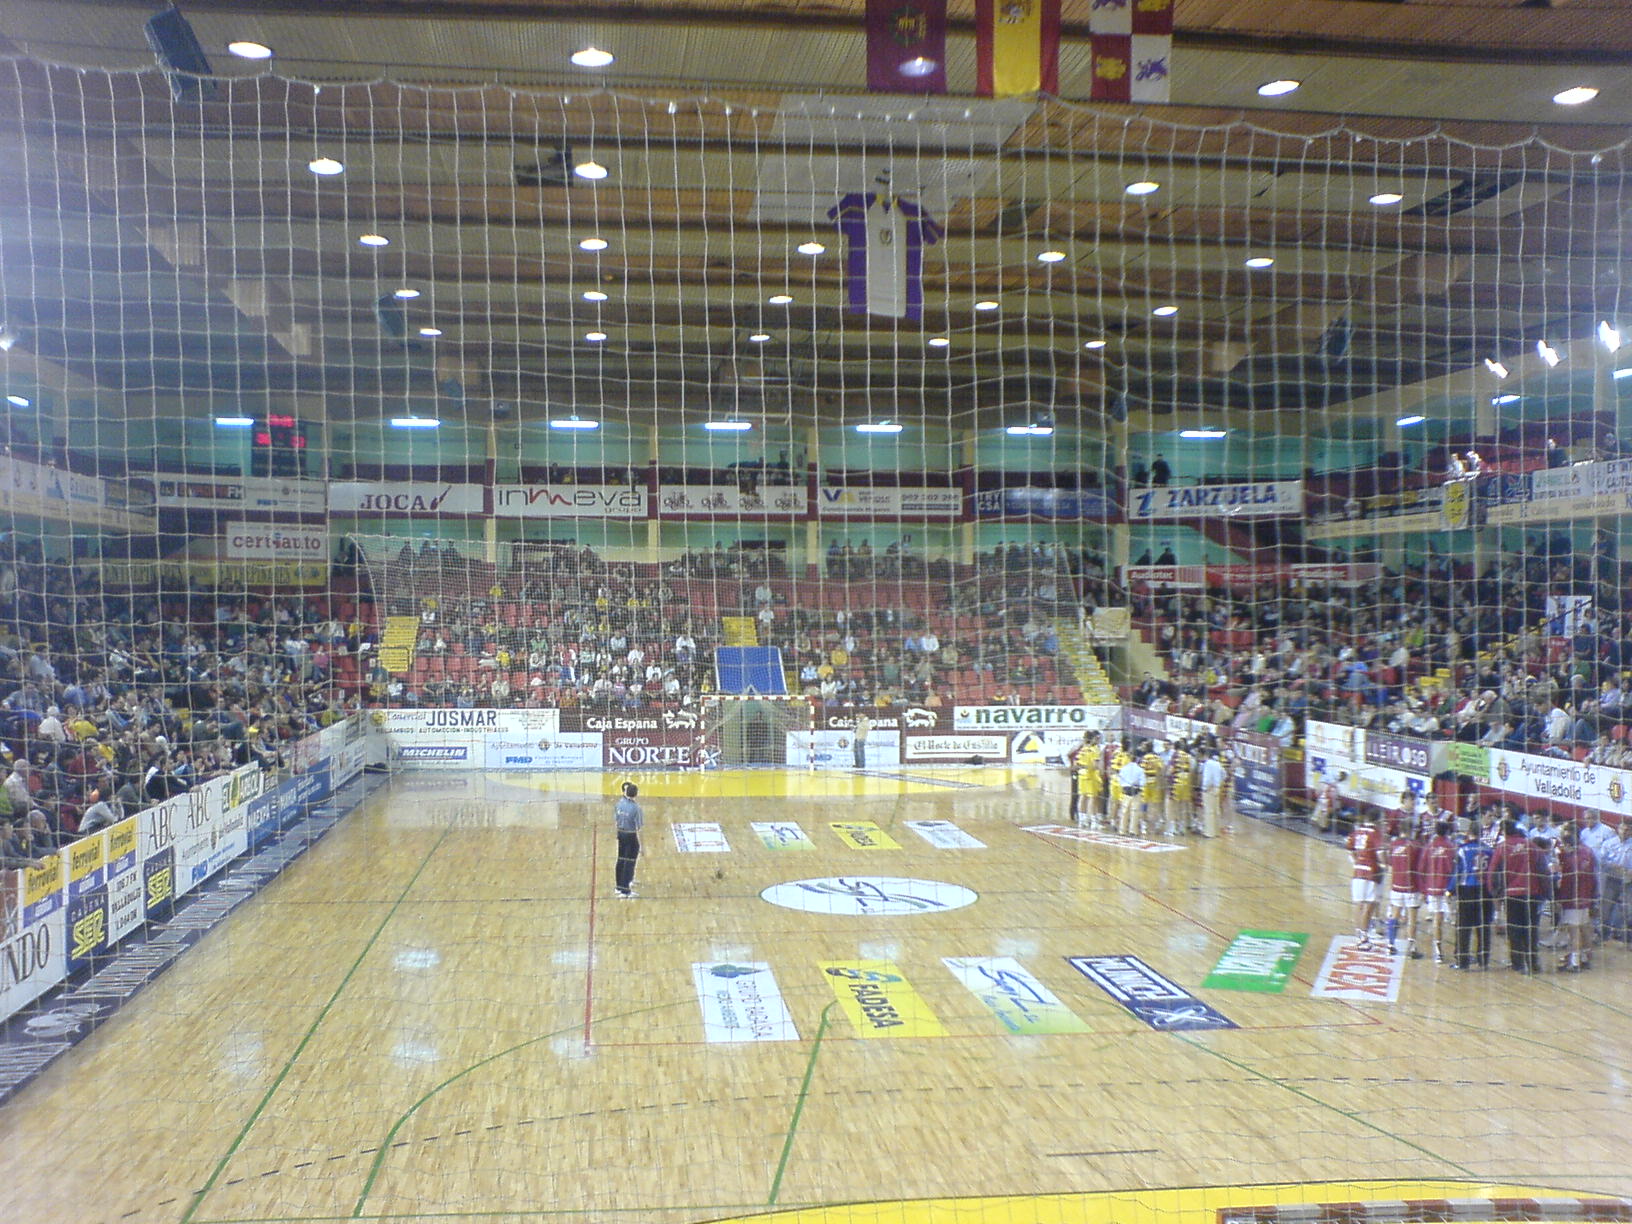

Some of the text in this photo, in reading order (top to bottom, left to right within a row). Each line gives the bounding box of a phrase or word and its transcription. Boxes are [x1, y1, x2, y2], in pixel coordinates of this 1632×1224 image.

[360, 494, 427, 511] JOCA
[498, 488, 642, 507] inmeva
[426, 710, 497, 726] JOSMAR
[586, 717, 658, 732] Caja España
[975, 707, 1087, 724] navarro
[402, 748, 466, 757] MICHELIN
[608, 746, 690, 765] NORTE
[1520, 758, 1596, 785] Ayuntamiento de
[1534, 778, 1582, 800] Valladolid
[148, 802, 178, 853] ABC
[71, 907, 108, 960] SER
[847, 983, 905, 1030] FADESA
